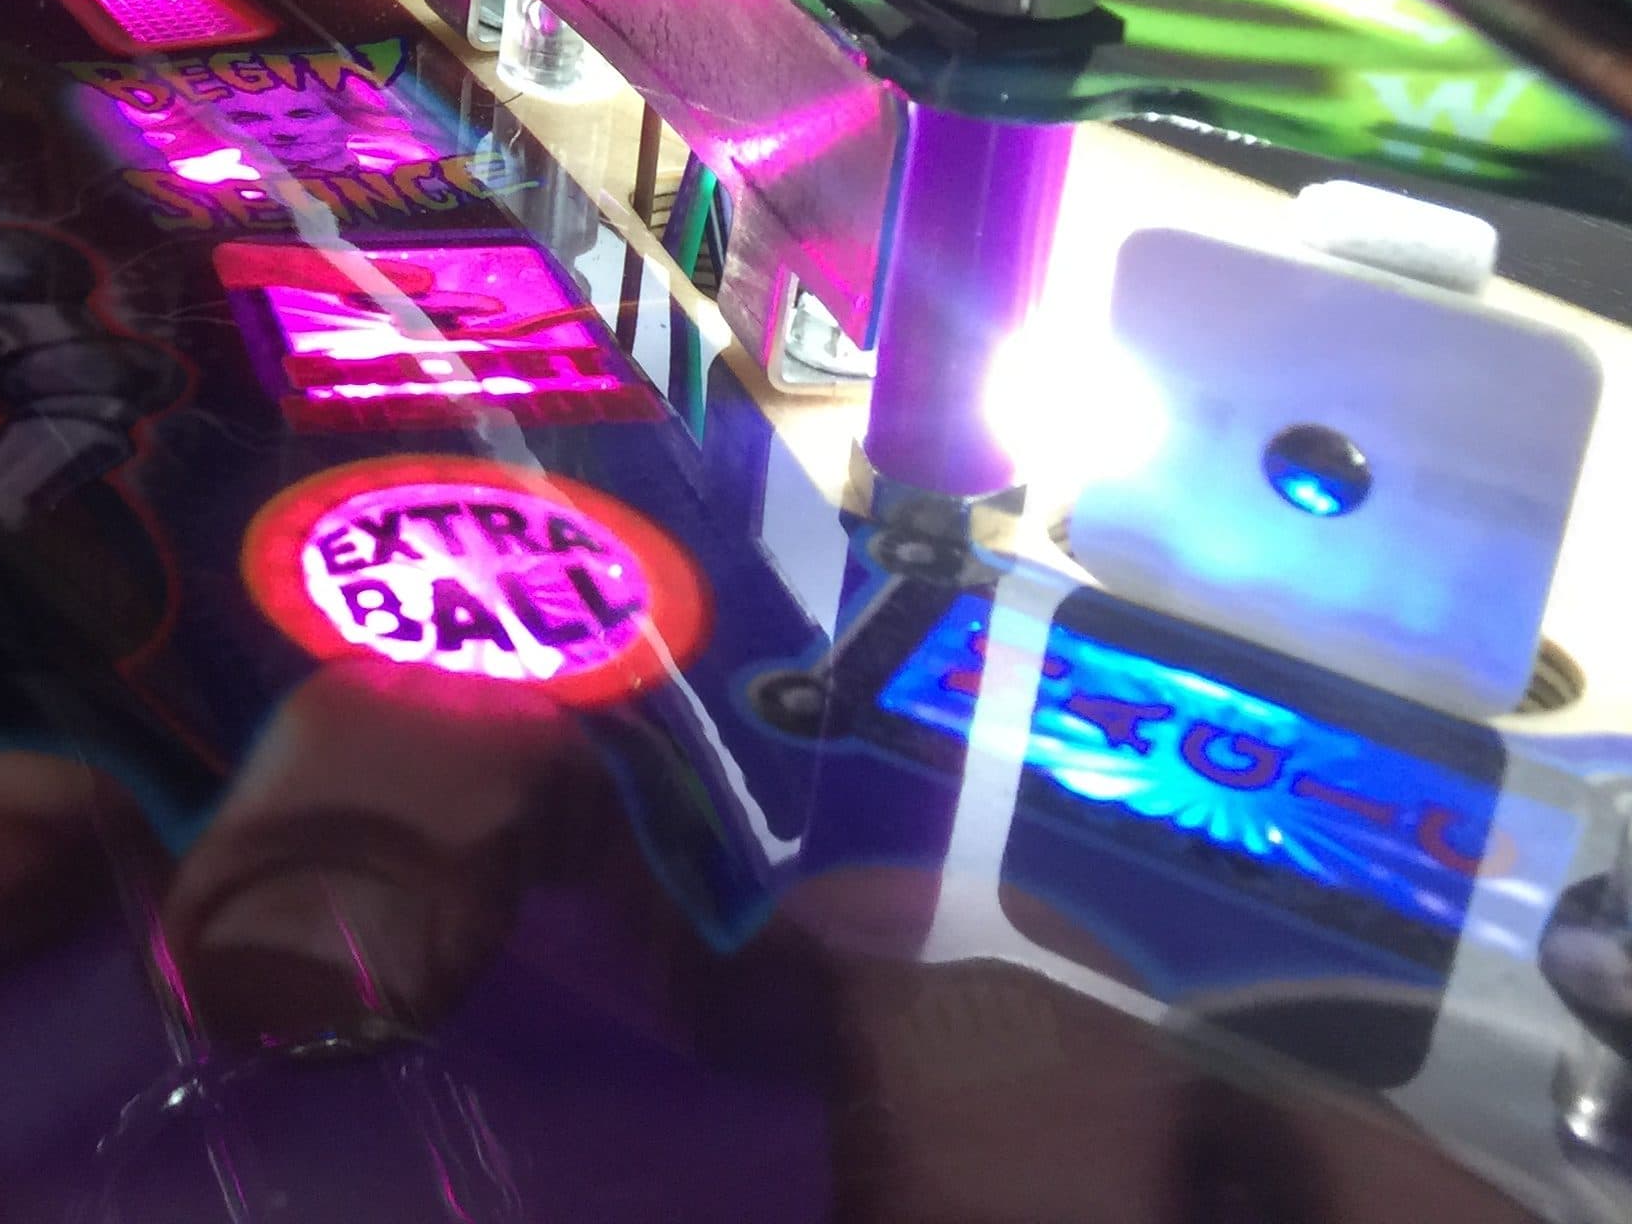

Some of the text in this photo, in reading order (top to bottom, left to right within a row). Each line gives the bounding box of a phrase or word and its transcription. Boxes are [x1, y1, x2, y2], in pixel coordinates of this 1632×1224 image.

[61, 40, 405, 111] BEGIN
[318, 502, 606, 576] EXTRA
[339, 563, 643, 652] BALL
